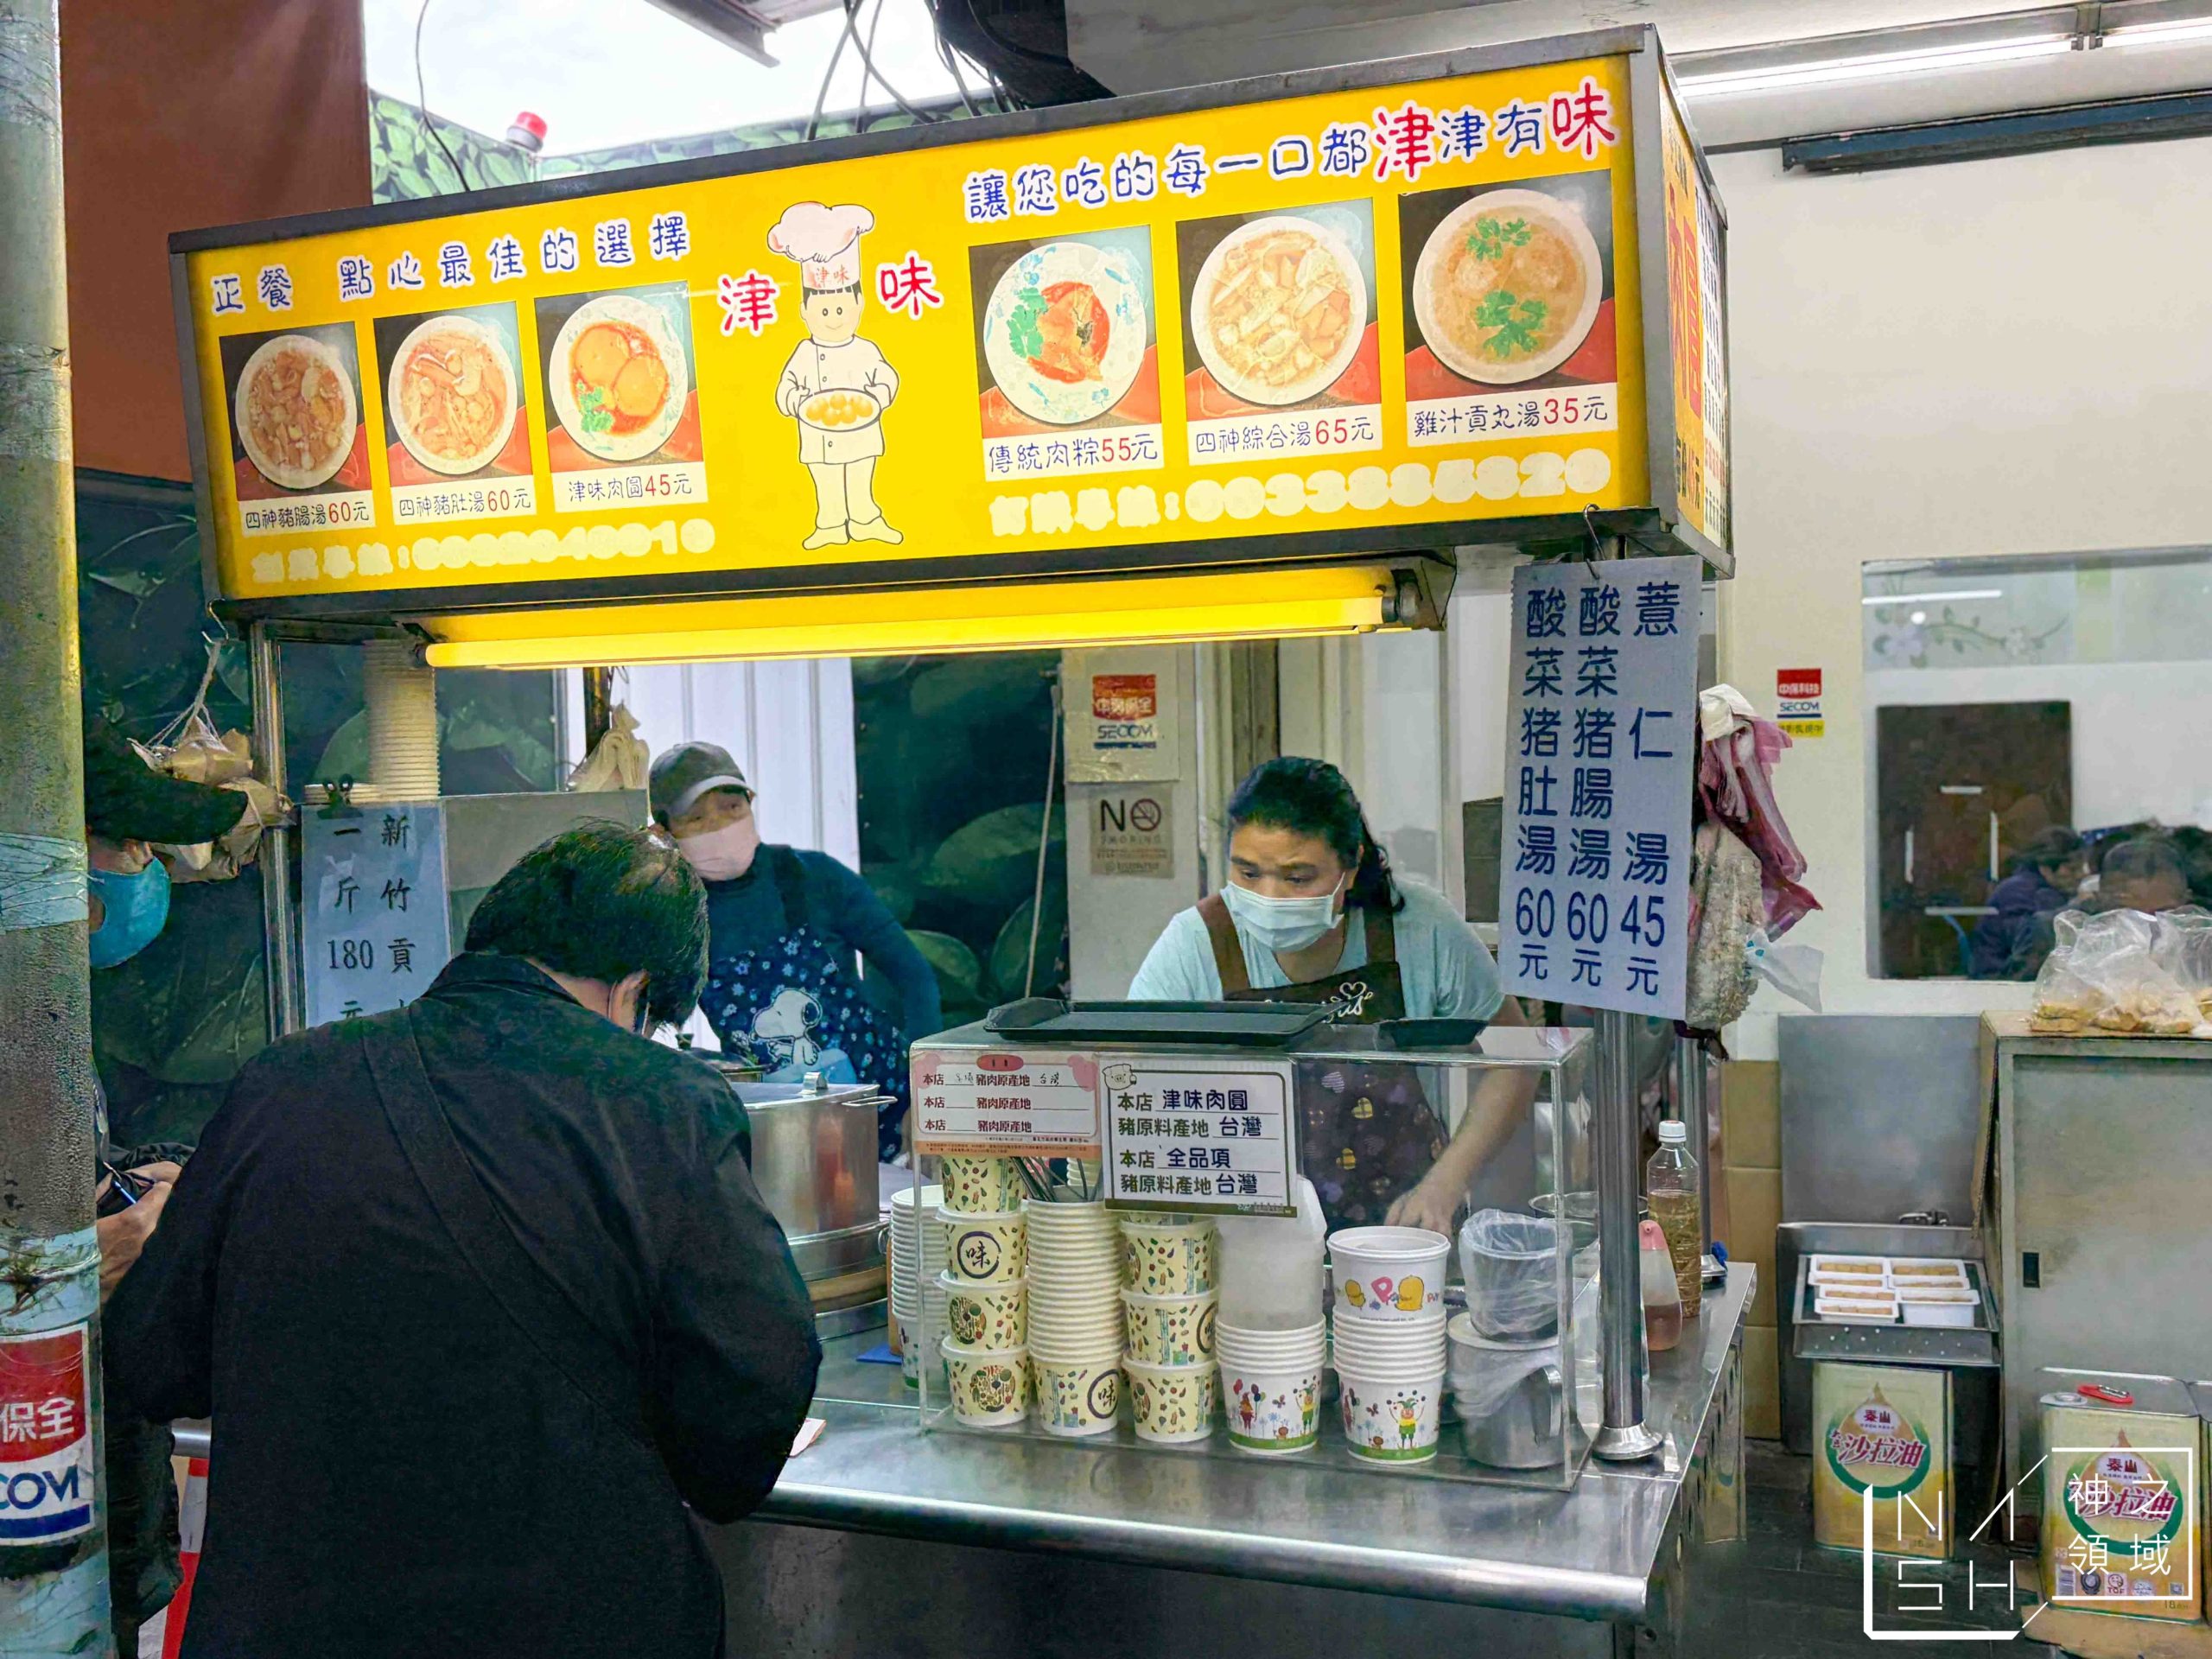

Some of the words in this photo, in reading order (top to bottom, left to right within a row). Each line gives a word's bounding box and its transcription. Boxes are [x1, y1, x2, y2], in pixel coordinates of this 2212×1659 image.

[964, 82, 1615, 218] 讓您吃的每一口都津津有味
[212, 274, 292, 313] 正餐
[340, 215, 689, 300] 點心最佳的選擇
[721, 274, 779, 333] 津
[880, 256, 940, 317] 味
[1414, 395, 1608, 438] 雞汁貢丸湯35元
[1195, 416, 1375, 454] 四神綜合湯65元
[988, 433, 1159, 474] 傳統肉粽55元
[397, 486, 533, 518] 四神豬肚湯60元
[568, 473, 693, 503] 津味肉圓45元
[245, 499, 371, 530] 四神豬腸湯60元
[1780, 702, 1820, 712] SECOM
[1097, 724, 1154, 740] SECOM
[380, 813, 416, 1008] 新竹貢
[923, 1073, 944, 1086] 本店
[976, 1074, 1031, 1087] 豬肉原產地
[924, 1096, 945, 1109] 本店
[976, 1097, 1032, 1110] 豬肉原產地
[1117, 1092, 1154, 1112] 本店
[1162, 1089, 1249, 1111] 津味肉圓
[924, 1119, 946, 1132] 本店
[977, 1120, 1033, 1133] 豬肉原產地
[1118, 1117, 1210, 1139] 豬原料產地
[1218, 1116, 1262, 1137] 台灣
[1119, 1149, 1155, 1168] 本店
[1166, 1147, 1231, 1169] 全品項
[1121, 1173, 1212, 1196] 豬原料產地
[1216, 1173, 1258, 1194] 台灣
[0, 1395, 76, 1443] 保全
[1863, 1409, 1891, 1424] 泰山
[1838, 1435, 1924, 1467] 沙拉油
[2106, 1457, 2138, 1473] 泰山
[0, 1464, 79, 1511] OM
